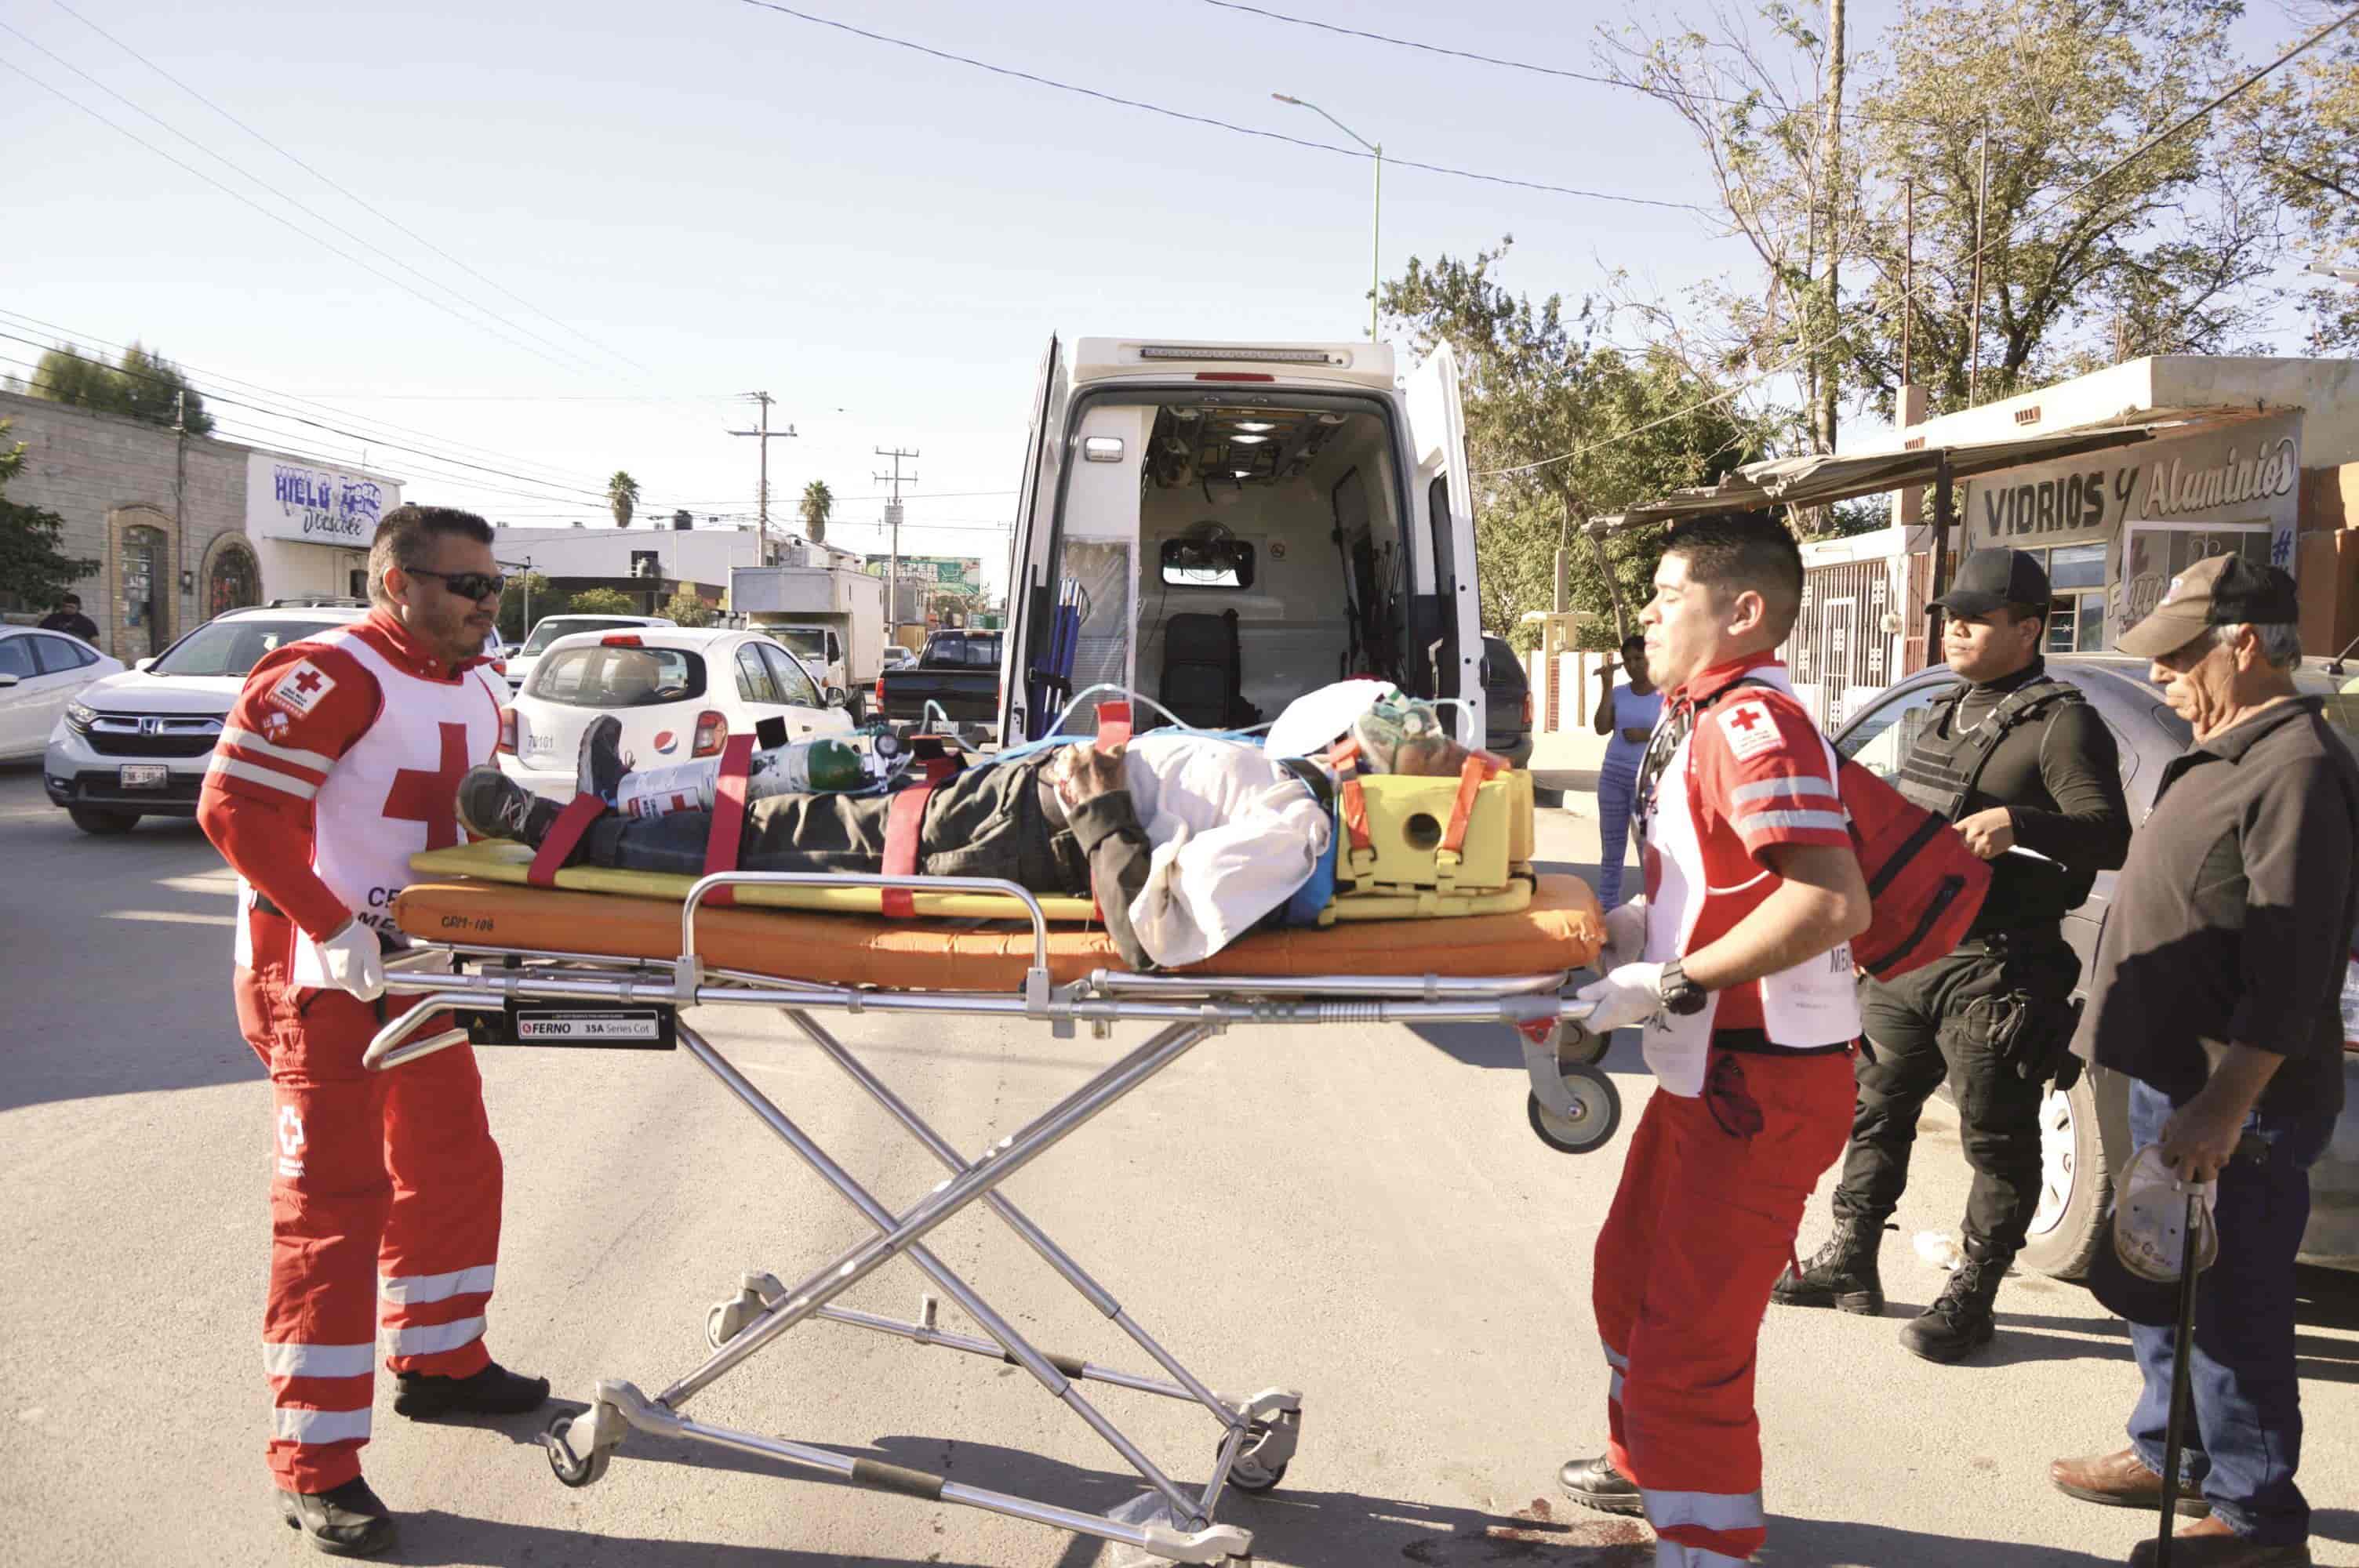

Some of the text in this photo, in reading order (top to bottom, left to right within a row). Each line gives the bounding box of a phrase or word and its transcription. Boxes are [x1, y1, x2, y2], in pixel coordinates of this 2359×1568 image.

[1984, 472, 2104, 536] VIDRIOS
[2140, 438, 2296, 521] Aluminios
[533, 1023, 571, 1034] FERNO
[585, 1024, 649, 1033] 35A Series Cot
